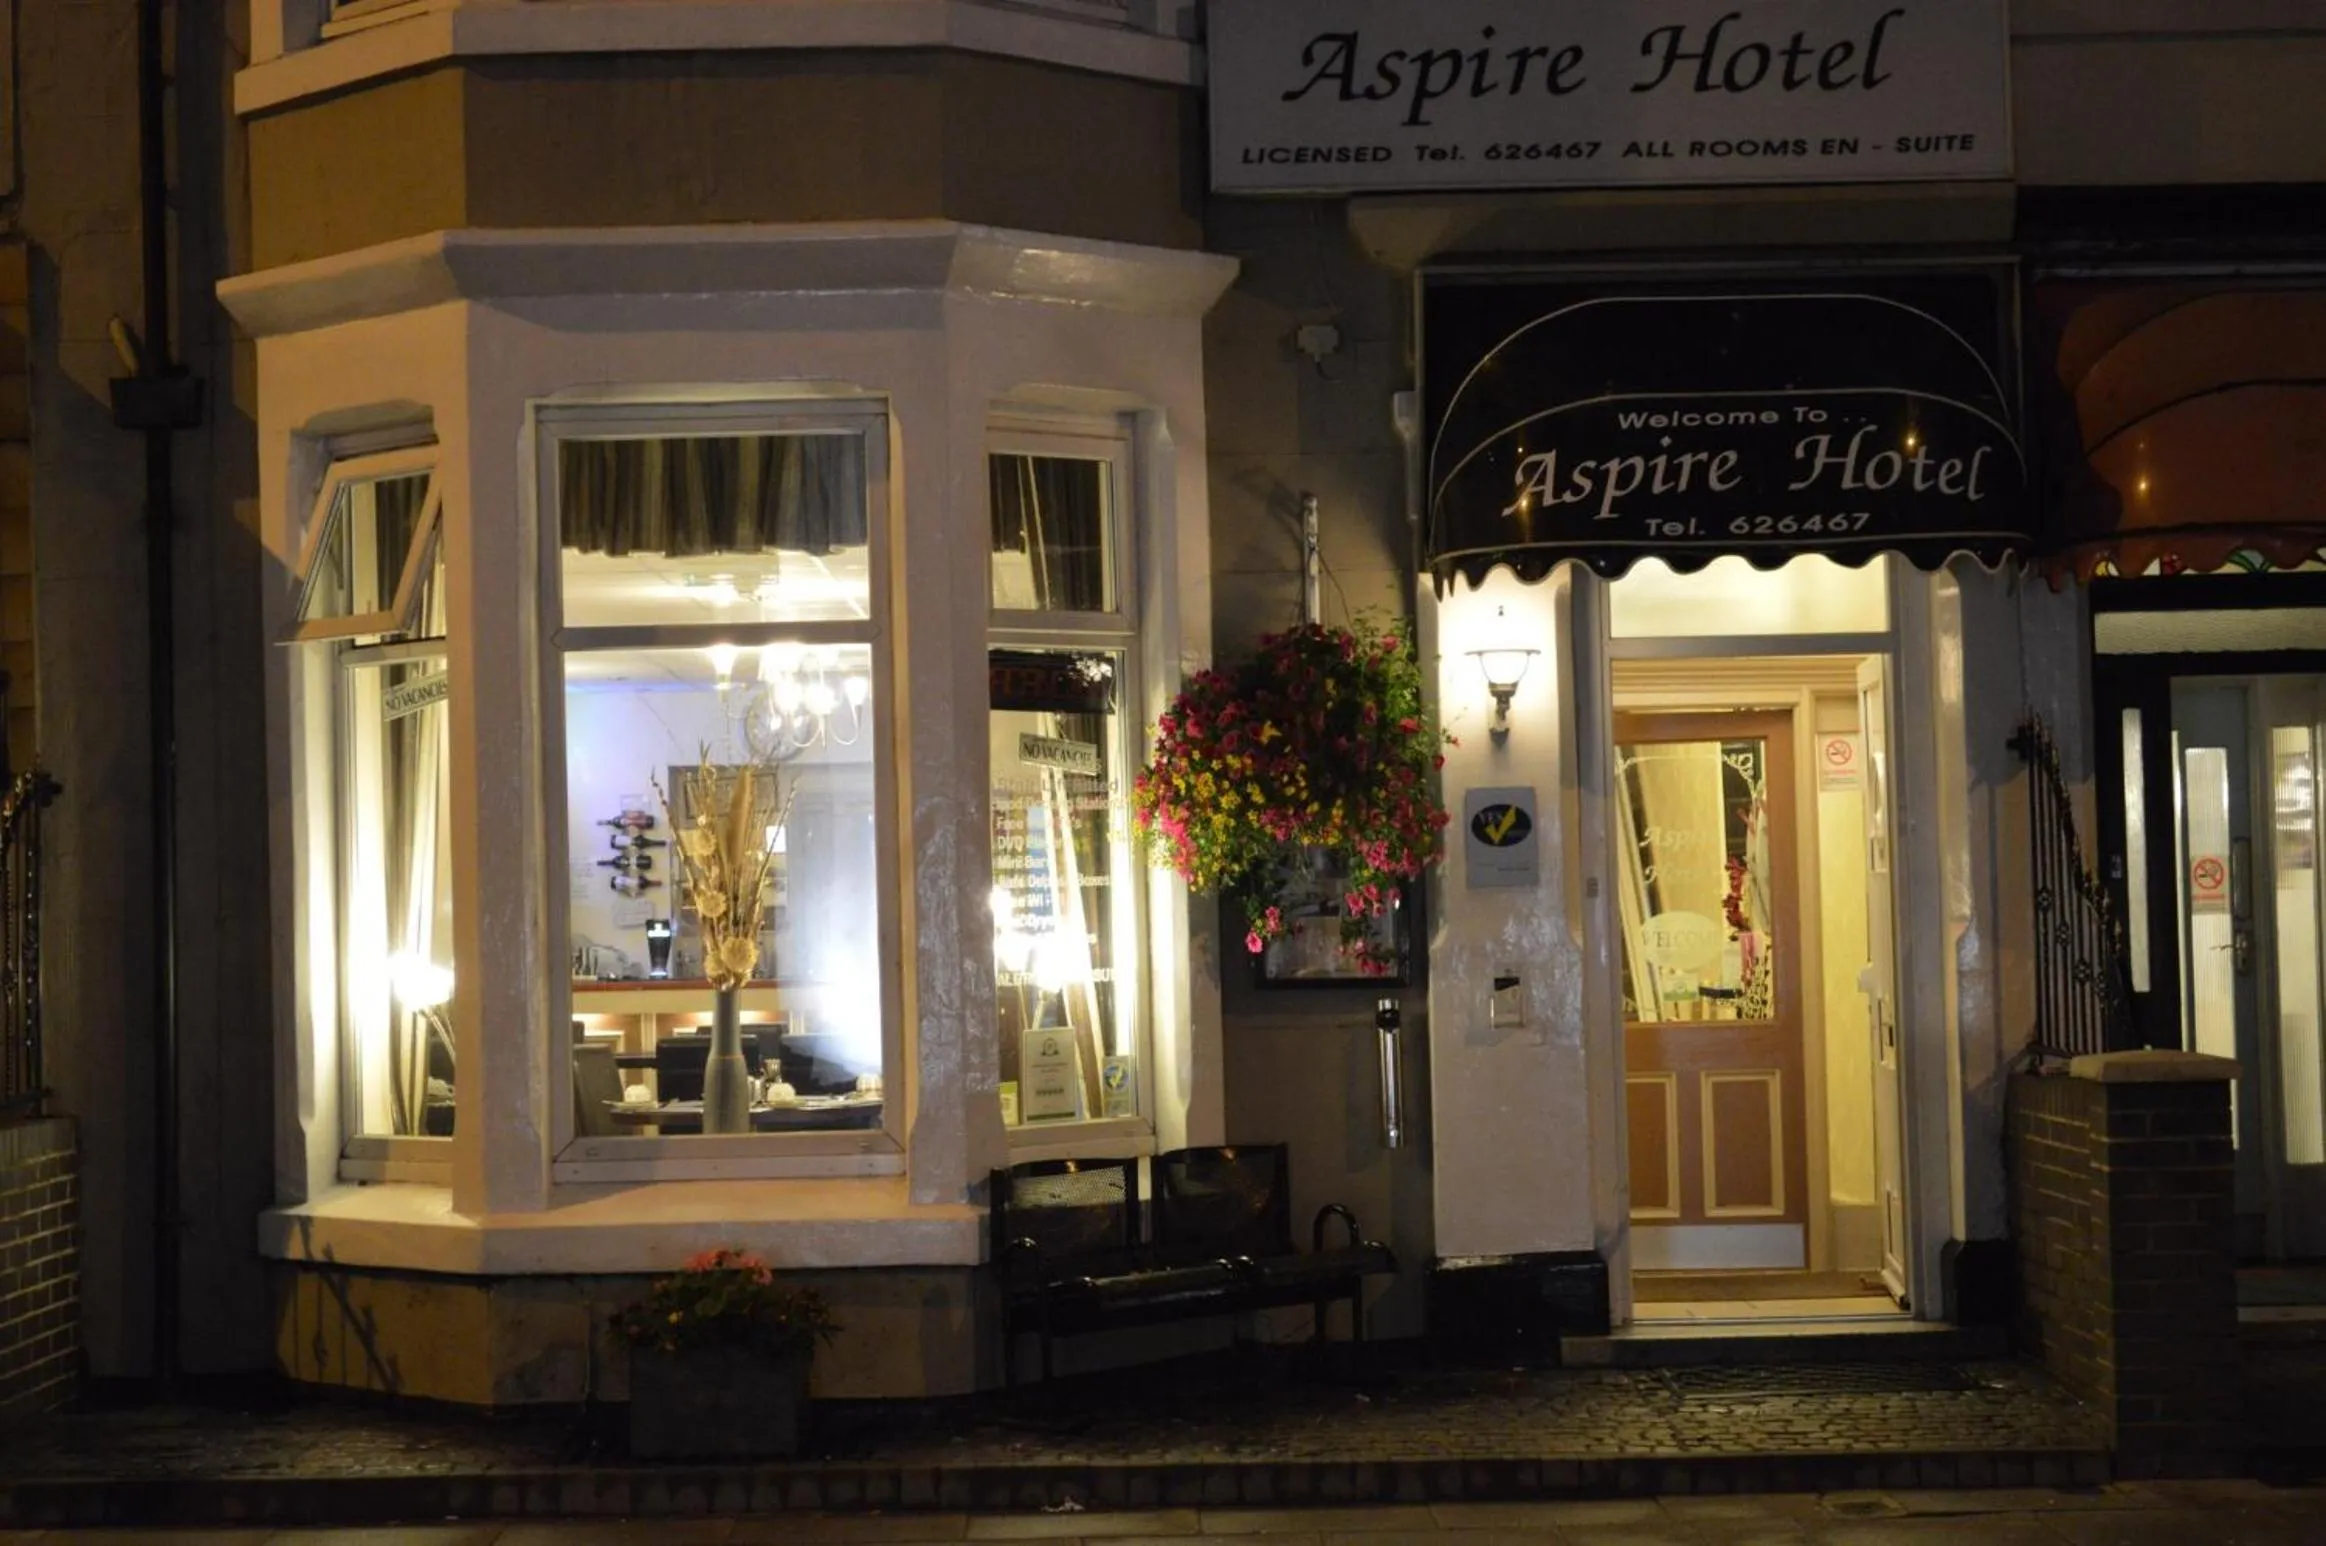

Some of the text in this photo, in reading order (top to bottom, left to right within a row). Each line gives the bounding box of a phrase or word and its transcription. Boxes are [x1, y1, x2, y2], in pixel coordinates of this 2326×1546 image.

[1280, 8, 1906, 127] Aspire Hotel
[1241, 146, 1393, 165] LICENSED
[1415, 144, 1465, 162] Tel.
[1483, 141, 1602, 161] 626467
[1621, 140, 1675, 158] ALL
[1688, 138, 1808, 158] ROOMS
[1819, 137, 1860, 156] EN
[1894, 133, 1975, 154] SUITE
[1617, 409, 1780, 430] Welcome
[1793, 406, 1828, 423] To
[1501, 424, 1992, 520] Aspire Hotel
[1645, 511, 1871, 538] Tel. 626467
